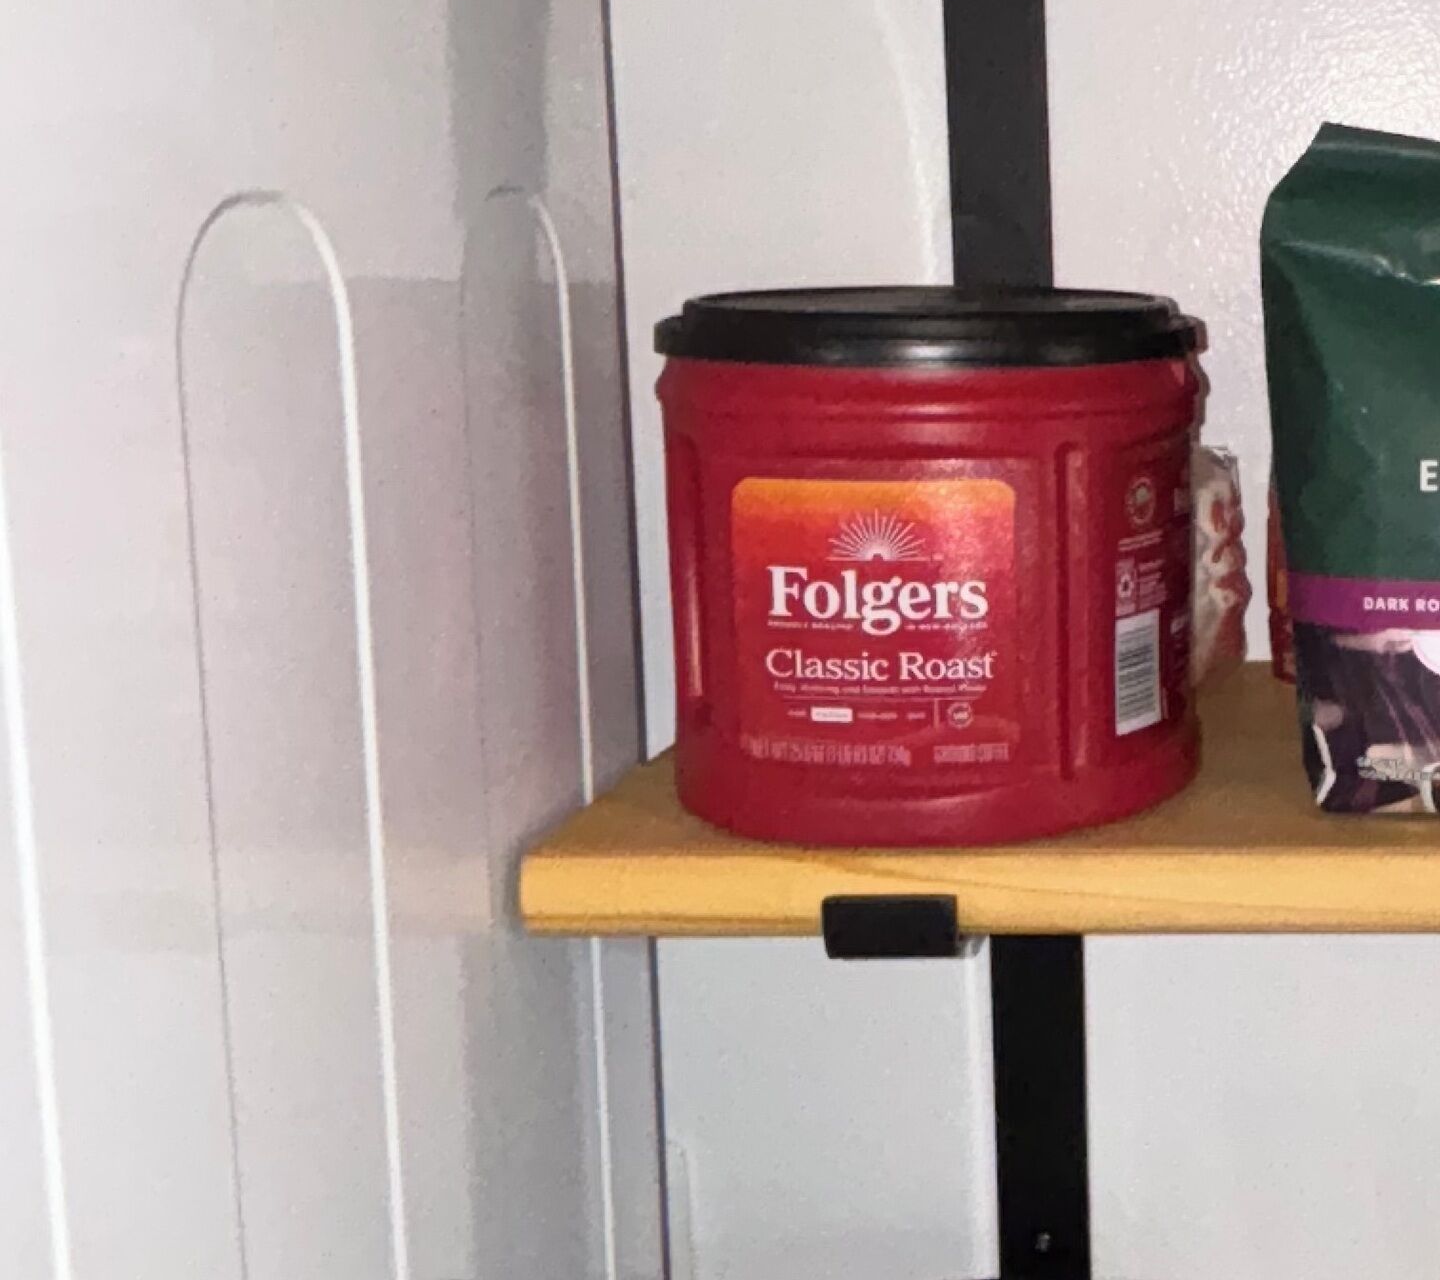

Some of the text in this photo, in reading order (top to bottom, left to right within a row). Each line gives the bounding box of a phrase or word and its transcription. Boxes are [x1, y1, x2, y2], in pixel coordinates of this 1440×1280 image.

[766, 566, 988, 636] Folgers
[1363, 597, 1409, 612] DARK
[766, 649, 994, 681] Classic Roast
